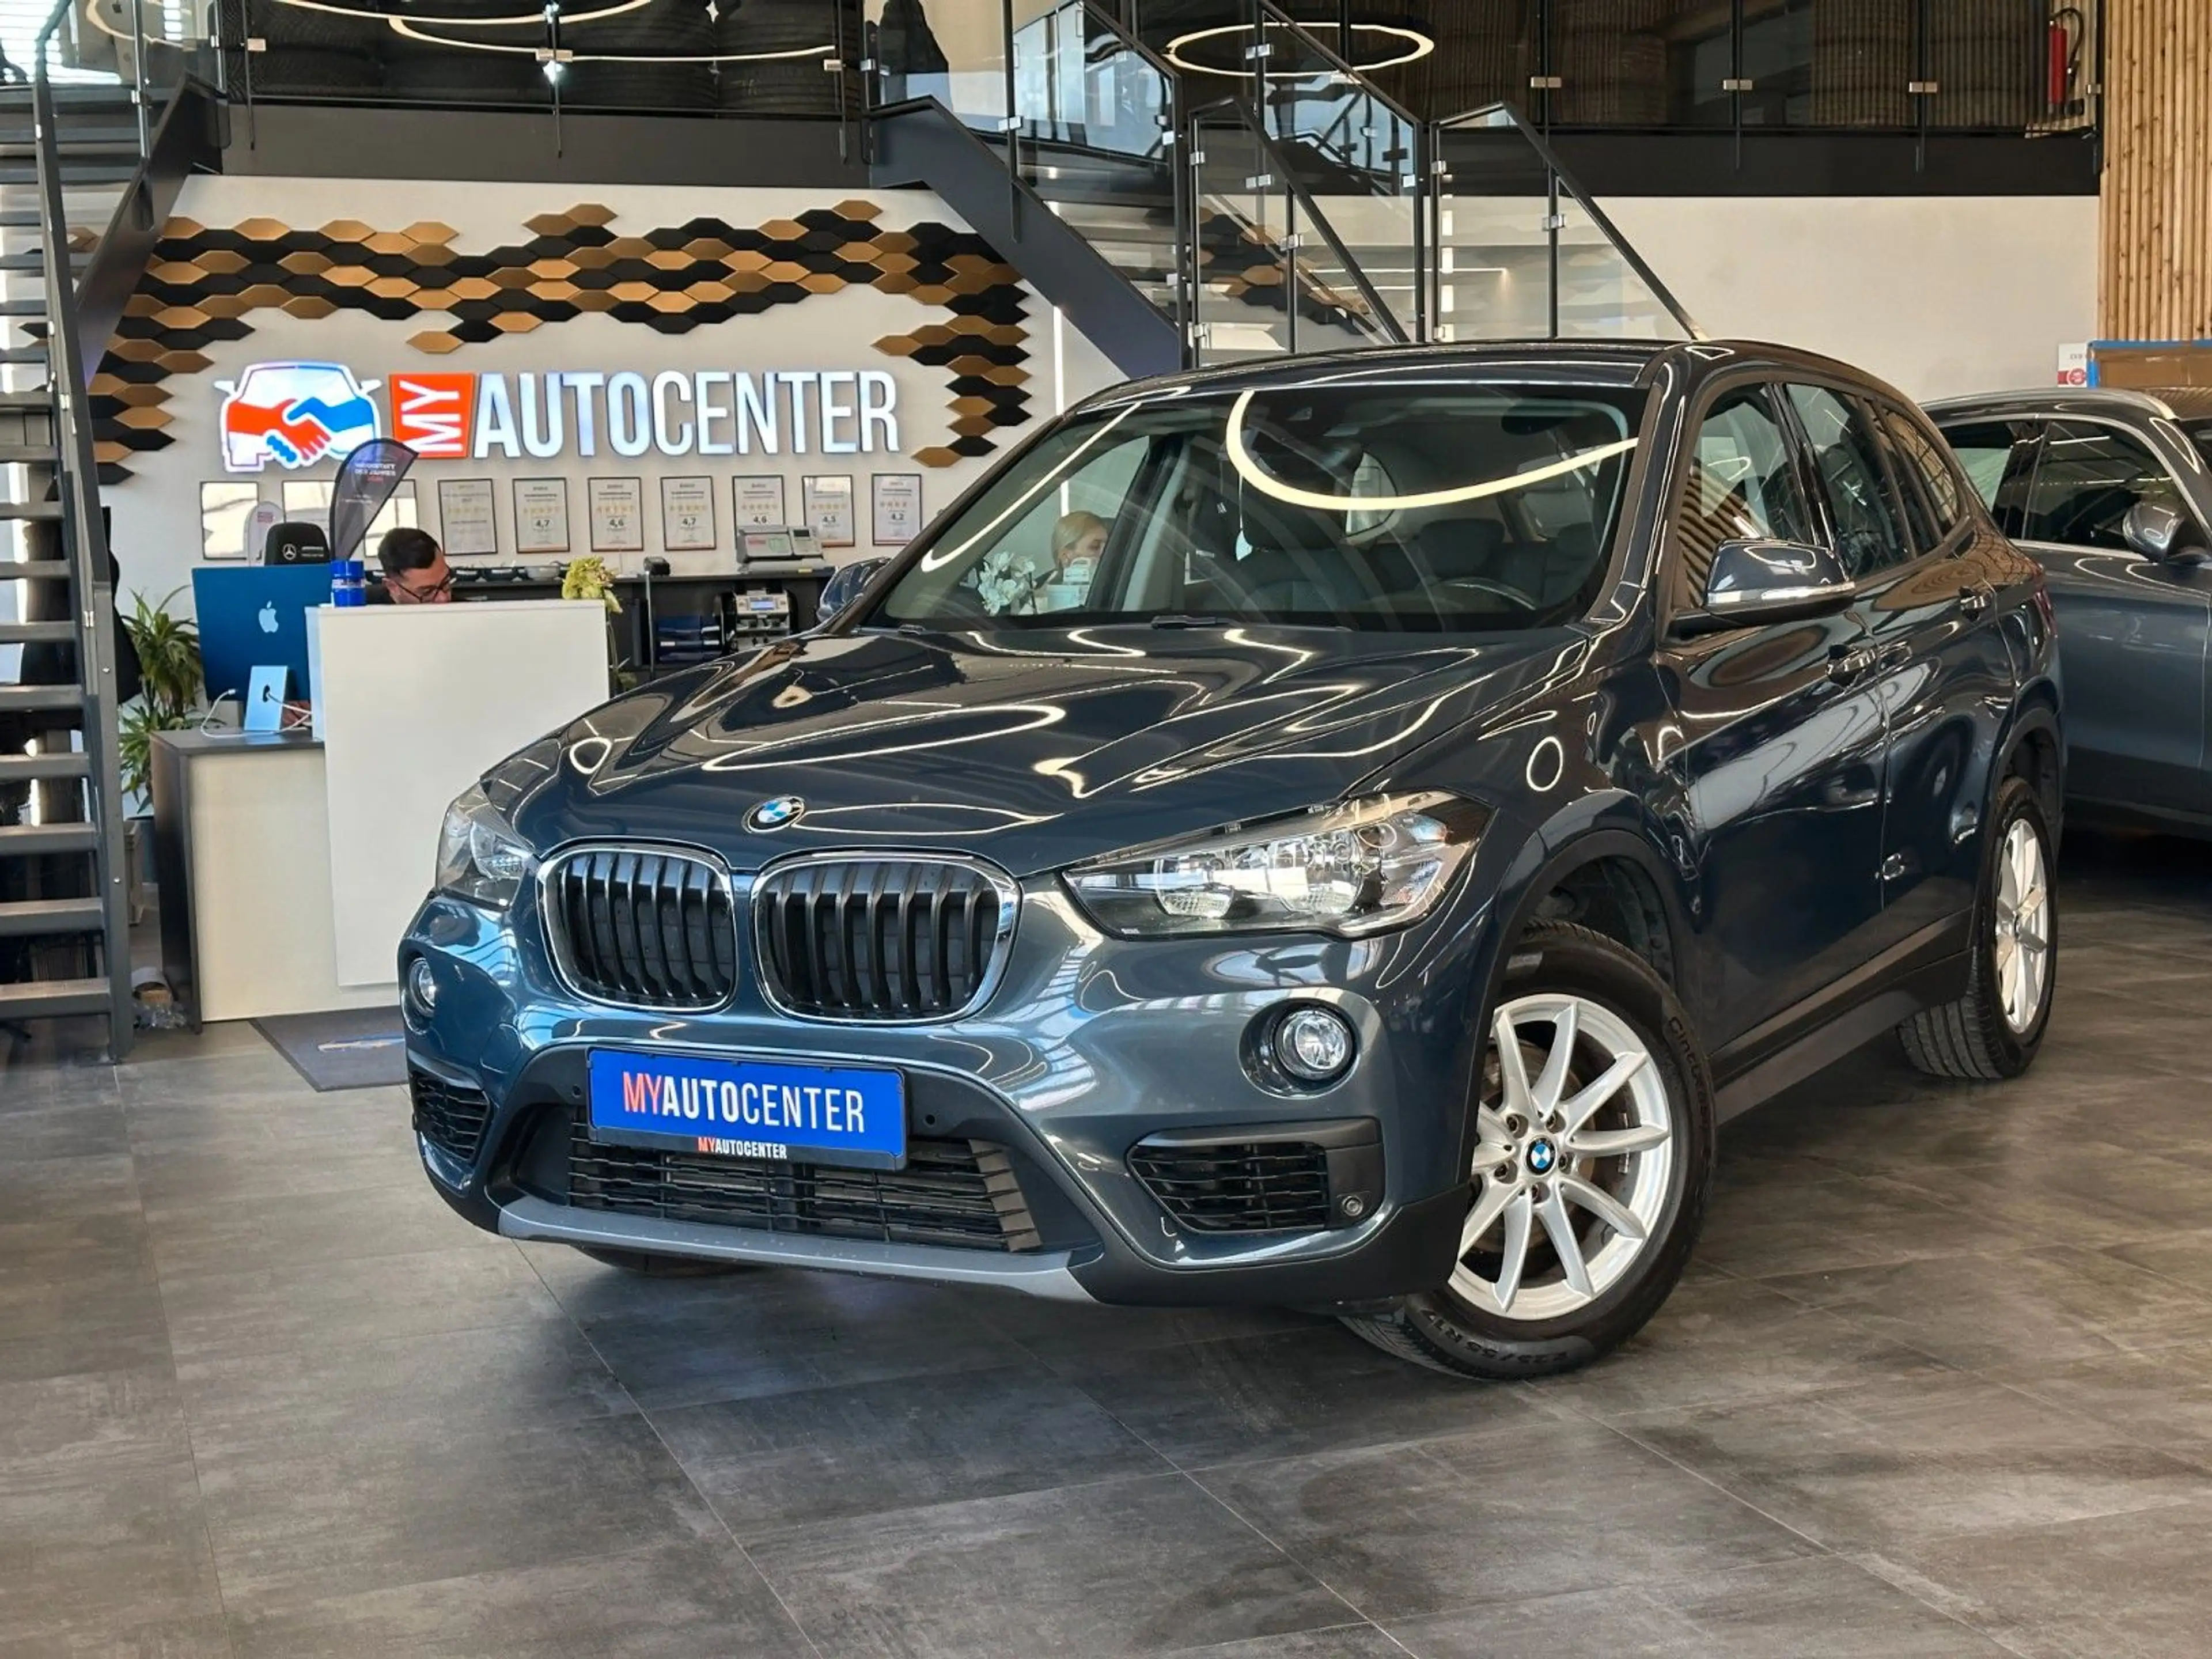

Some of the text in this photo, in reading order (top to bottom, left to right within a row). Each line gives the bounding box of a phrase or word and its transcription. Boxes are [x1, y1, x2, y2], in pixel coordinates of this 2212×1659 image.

[399, 370, 900, 458] MY AUTOCENTER
[622, 1071, 864, 1133] MYAUTOCENTER
[698, 1137, 787, 1160] MYAUTOCENTER
